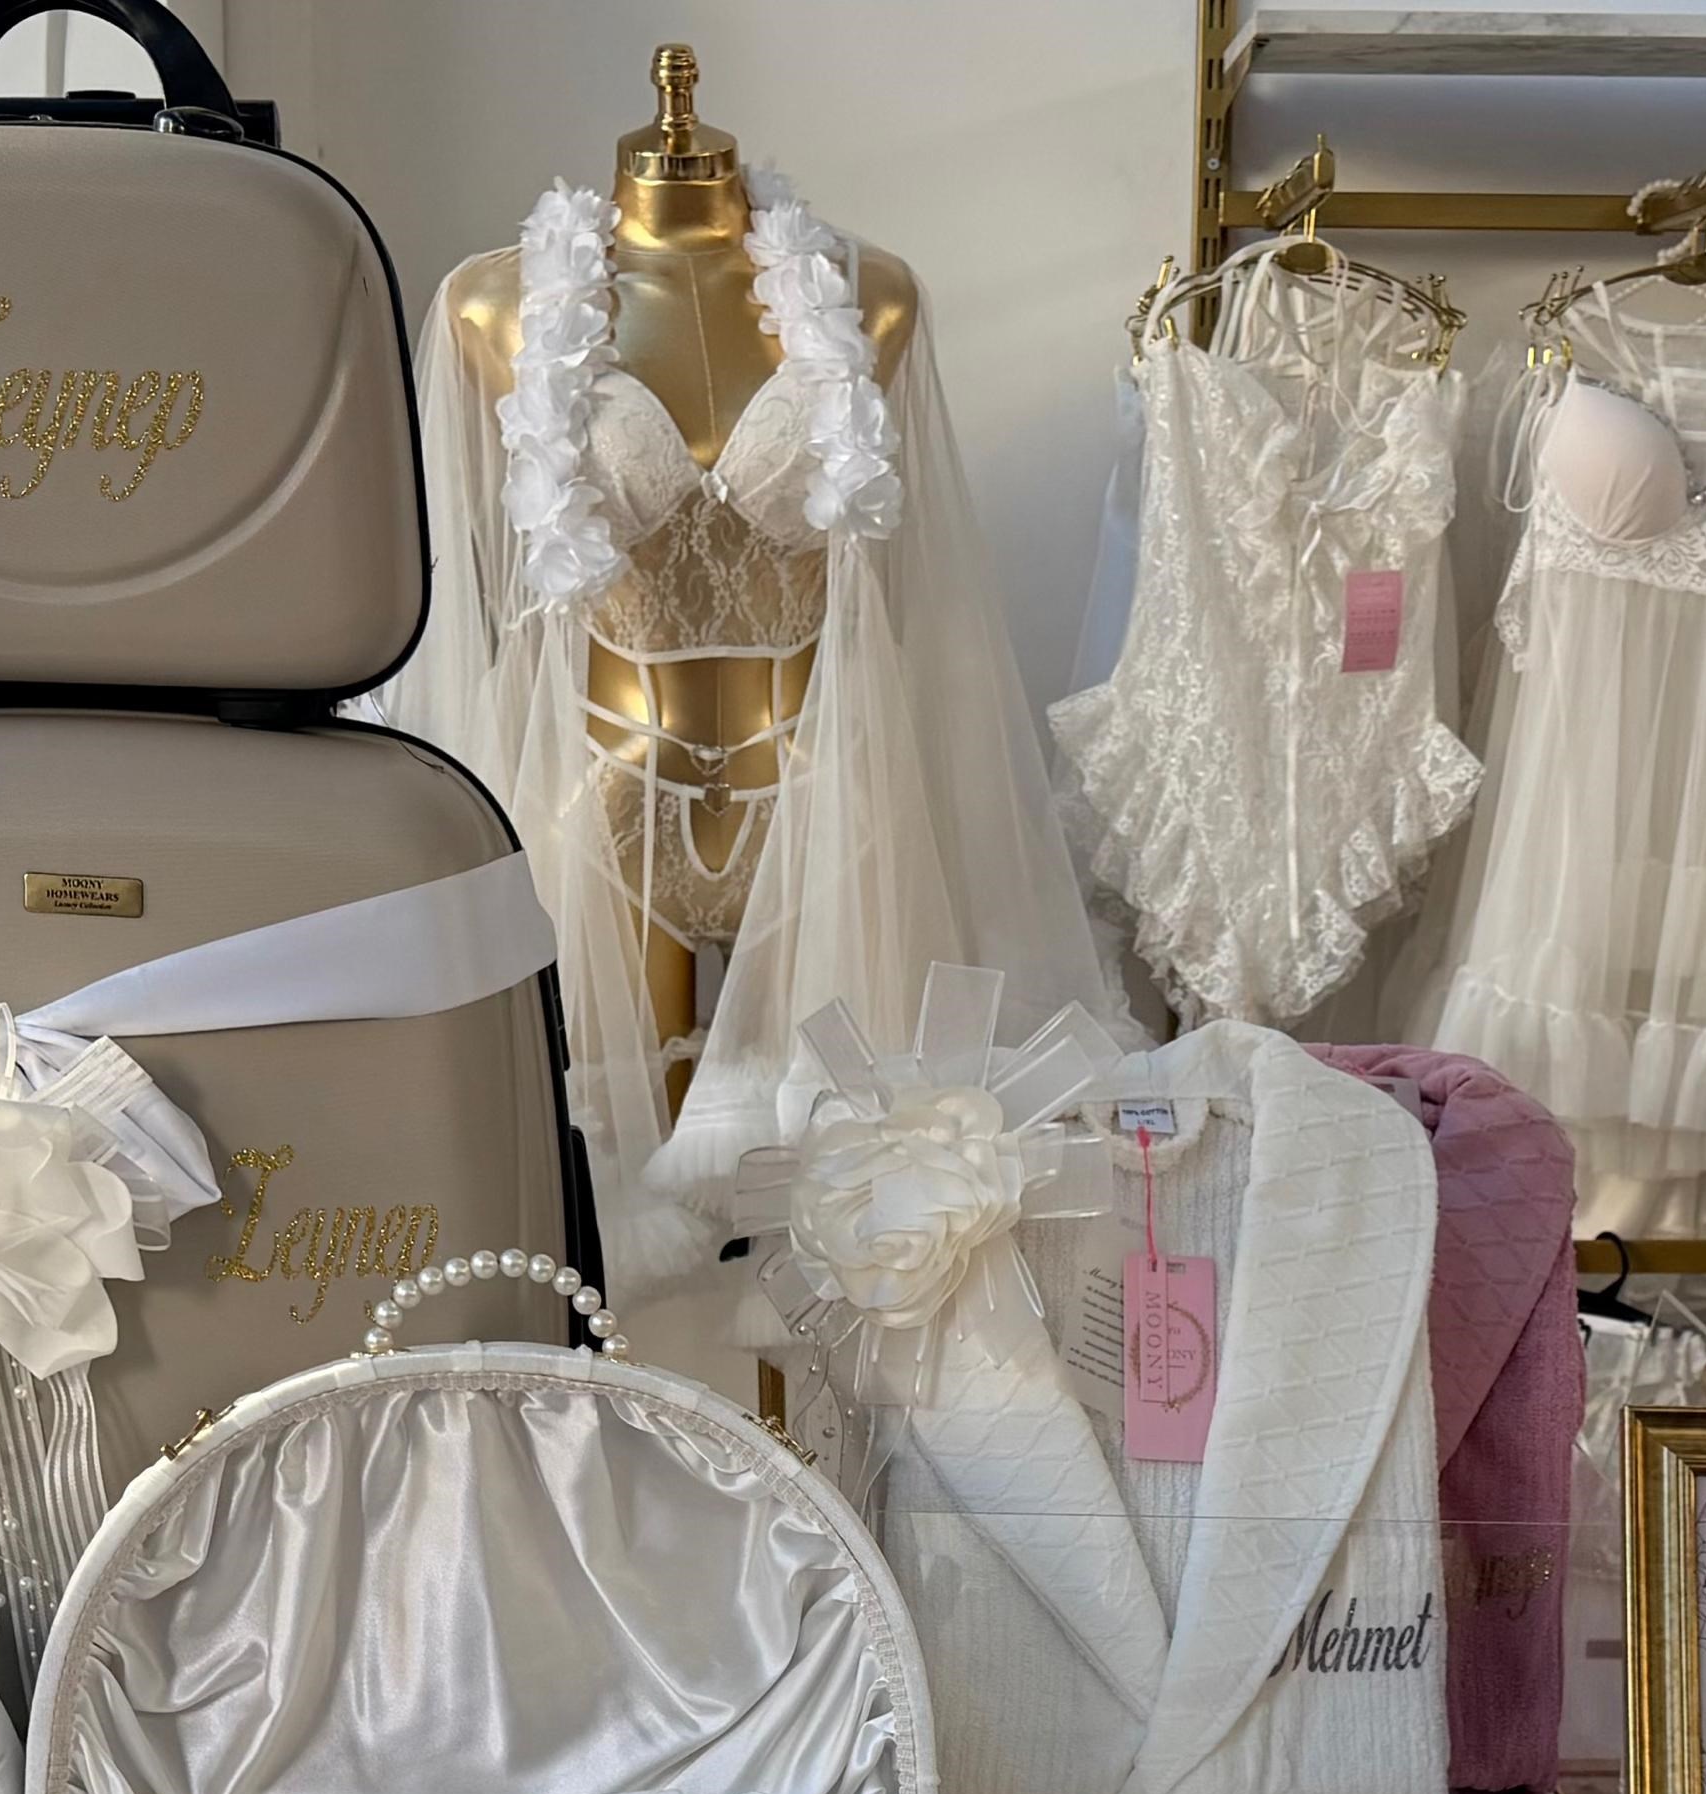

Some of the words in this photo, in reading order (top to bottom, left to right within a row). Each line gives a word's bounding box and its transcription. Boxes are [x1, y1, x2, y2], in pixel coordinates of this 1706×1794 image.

[46, 889, 119, 902] HOMEWEARS
[61, 878, 104, 889] MOONY
[205, 1143, 438, 1325] Zeynep
[1146, 1290, 1163, 1389] MOONY
[1268, 1589, 1432, 1680] Mehmet
